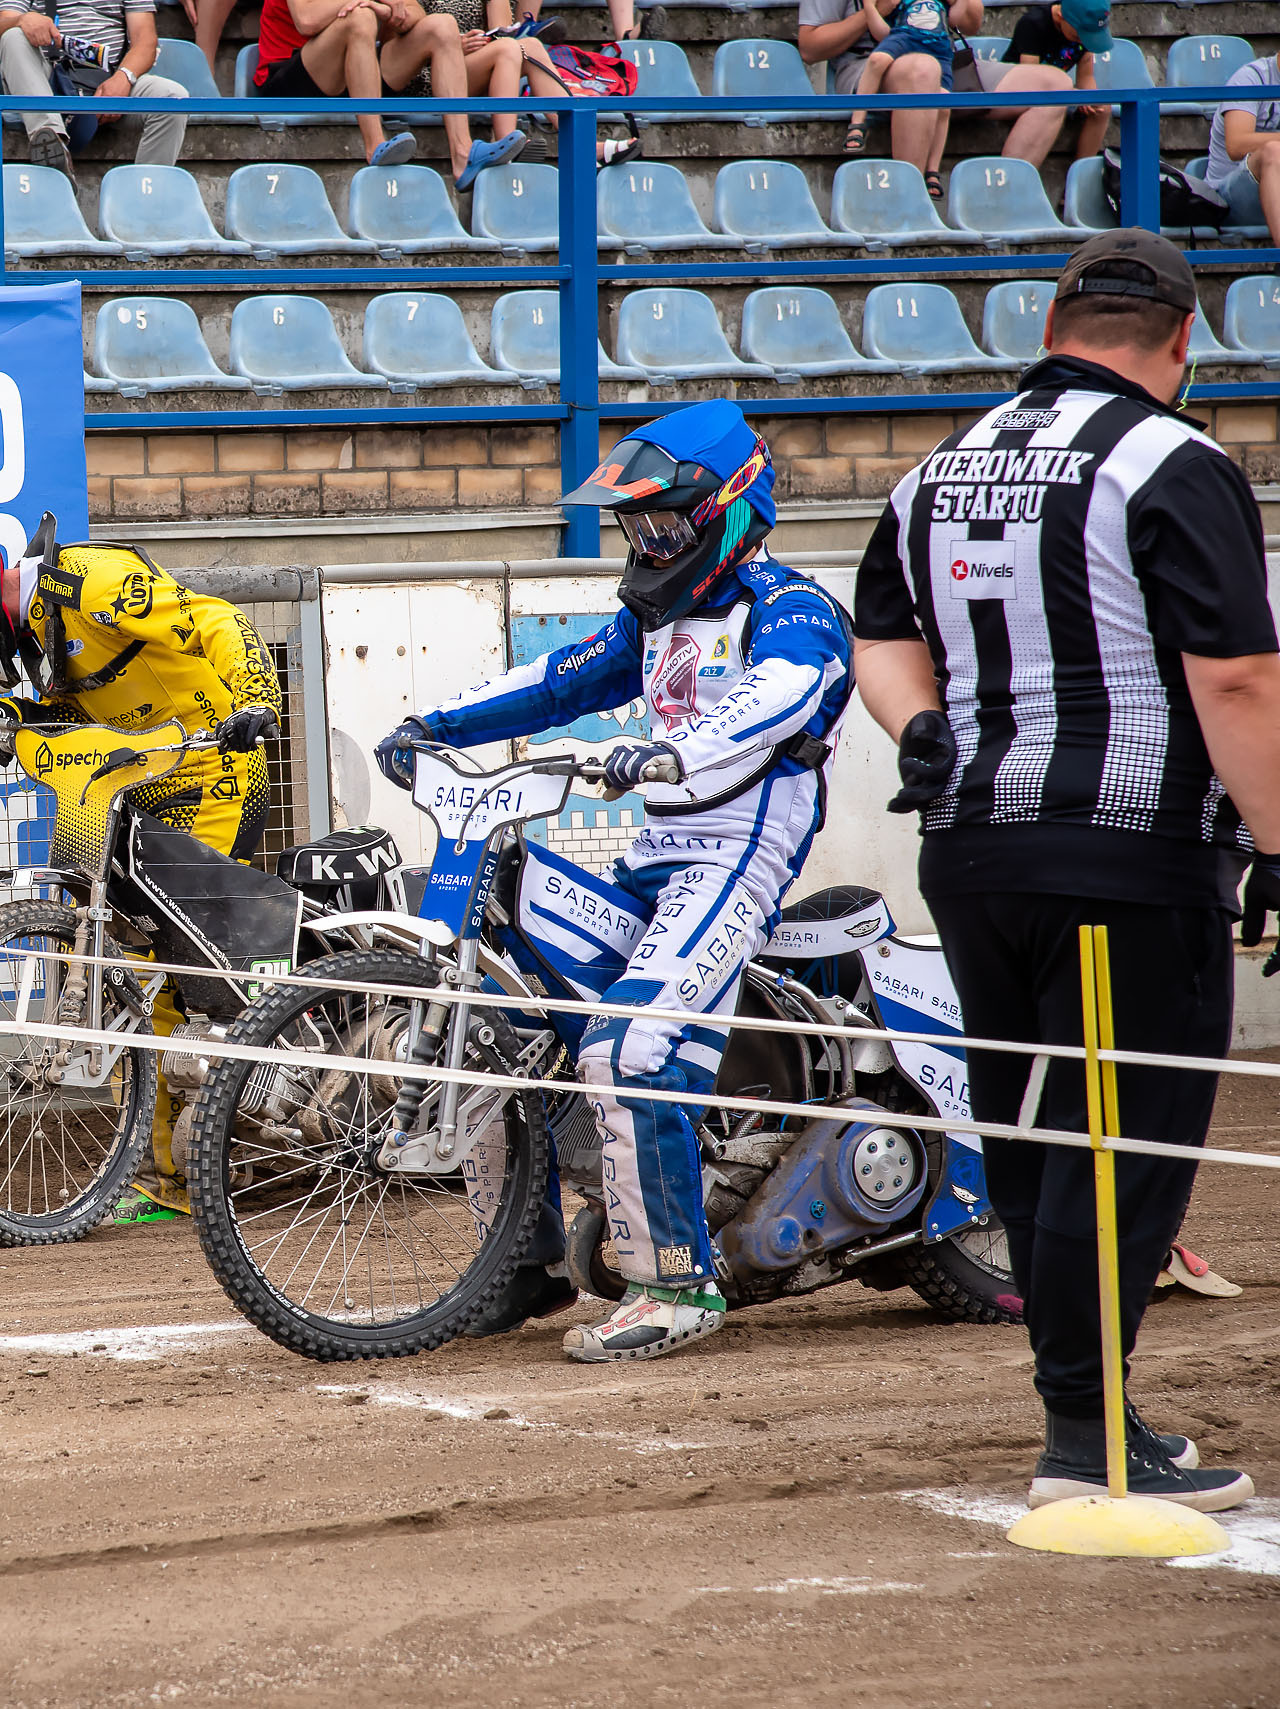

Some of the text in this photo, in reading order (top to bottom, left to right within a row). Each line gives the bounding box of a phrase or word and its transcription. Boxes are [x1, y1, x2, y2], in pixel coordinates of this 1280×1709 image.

[633, 48, 655, 67] 11
[747, 50, 770, 69] 12
[20, 174, 31, 194] 5
[141, 177, 152, 195] 6
[267, 175, 279, 194] 7
[512, 179, 524, 197] 9
[749, 172, 769, 190] 11
[866, 169, 890, 190] 12
[273, 306, 285, 325] 6
[407, 301, 419, 321] 7
[896, 298, 919, 318] 11
[136, 310, 148, 330] 5
[921, 449, 1096, 485] KIEROWNIK
[931, 484, 1049, 523] STARTU
[692, 535, 746, 600] SCOTT
[970, 563, 1014, 578] Nivels
[652, 645, 693, 694] LOKOMOTIV
[711, 697, 761, 736] SPORTS
[434, 786, 523, 813] SAGARI
[448, 813, 487, 824] SPORTS
[430, 873, 473, 887] SAGARI
[471, 858, 497, 928] SAGARI
[545, 876, 638, 941] SAGARI
[569, 907, 610, 936] SPORTS
[679, 891, 758, 1002] SAGARI
[770, 931, 819, 944] AGARI
[712, 937, 746, 988] SPORTS
[873, 970, 925, 1000] SAGARI
[885, 986, 908, 999] SPORTS
[931, 996, 962, 1017] SAG
[943, 1012, 962, 1022] SPORT
[943, 1099, 974, 1120] SPO
[592, 1100, 635, 1256] SAGARI
[232, 1222, 264, 1277] PLATINUM
